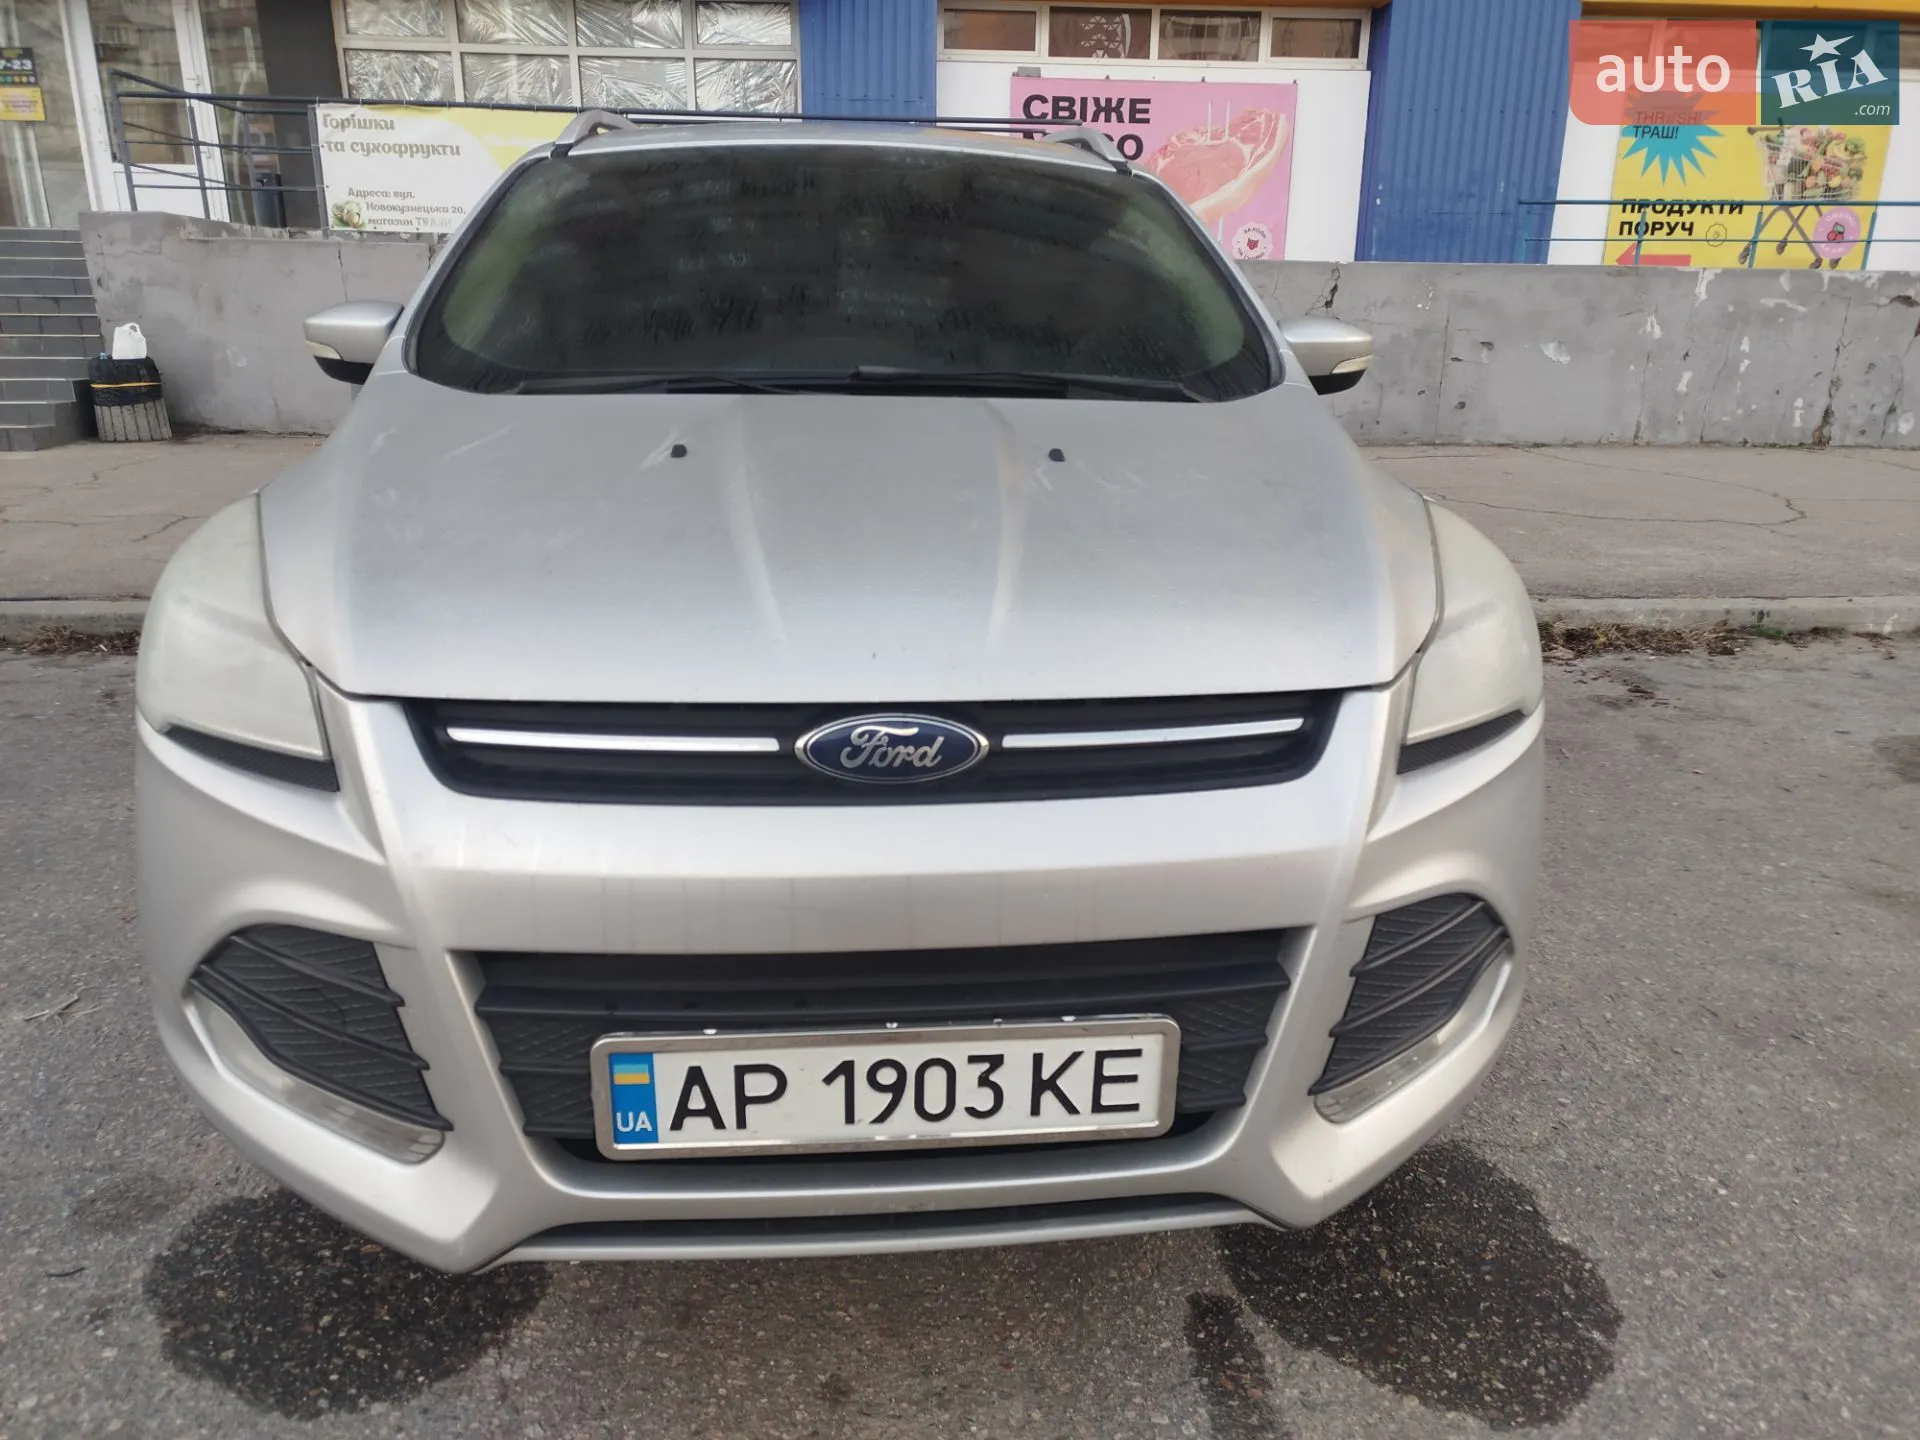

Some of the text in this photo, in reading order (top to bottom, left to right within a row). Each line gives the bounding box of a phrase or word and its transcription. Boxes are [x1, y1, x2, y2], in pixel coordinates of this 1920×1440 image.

[1022, 94, 1151, 124] СВІЖЕ
[322, 113, 395, 132] Горішки
[1633, 125, 1679, 139] ТРАШ!
[325, 140, 461, 159] та сухофрукти
[348, 187, 415, 200] Адреса: вул.
[1622, 199, 1744, 217] ПРОДУКТИ
[368, 217, 413, 227] магазин
[1619, 221, 1694, 236] ПОРУЧ
[840, 725, 945, 768] Ford
[669, 1048, 1144, 1131] AP 1903 KE
[616, 1110, 653, 1133] UA
